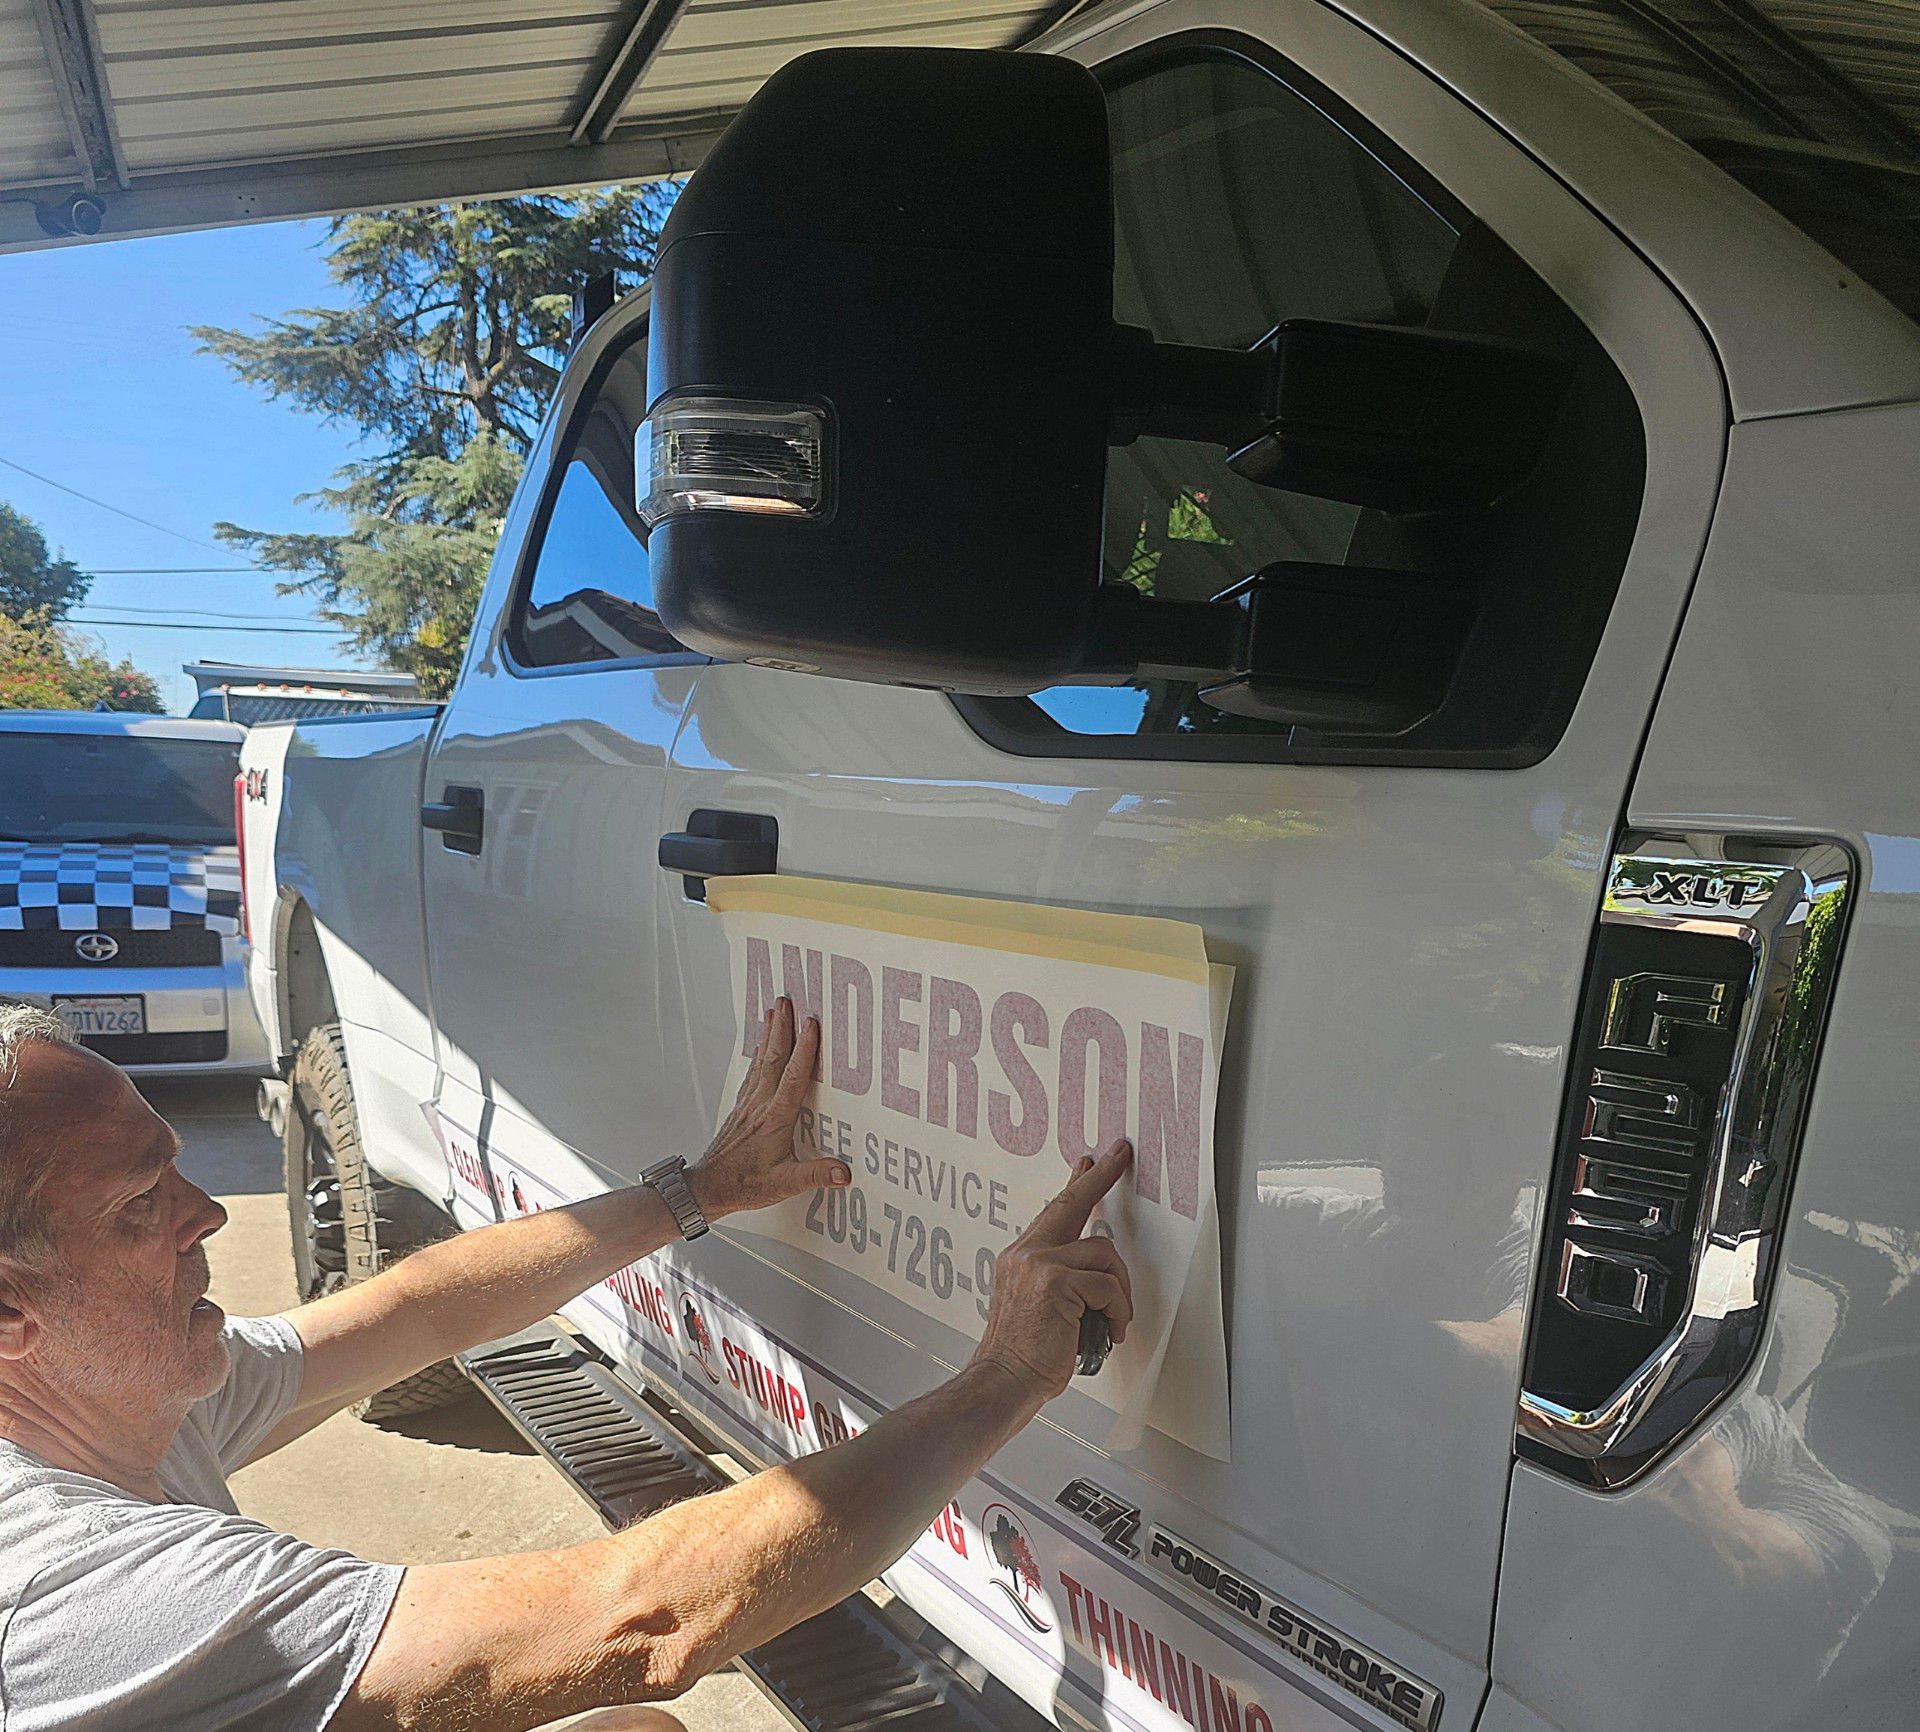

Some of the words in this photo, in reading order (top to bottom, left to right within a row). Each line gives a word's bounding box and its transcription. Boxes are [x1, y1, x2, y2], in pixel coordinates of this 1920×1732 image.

[1649, 873, 1760, 908] XLT
[64, 1011, 140, 1031] DTV262
[742, 936, 1204, 1221] ANDERSON
[798, 1106, 853, 1164] REE
[805, 1187, 996, 1321] 209-726-9
[722, 1337, 805, 1437] STUMP
[1151, 1532, 1261, 1619] POWER
[1267, 1605, 1424, 1718] STROKE
